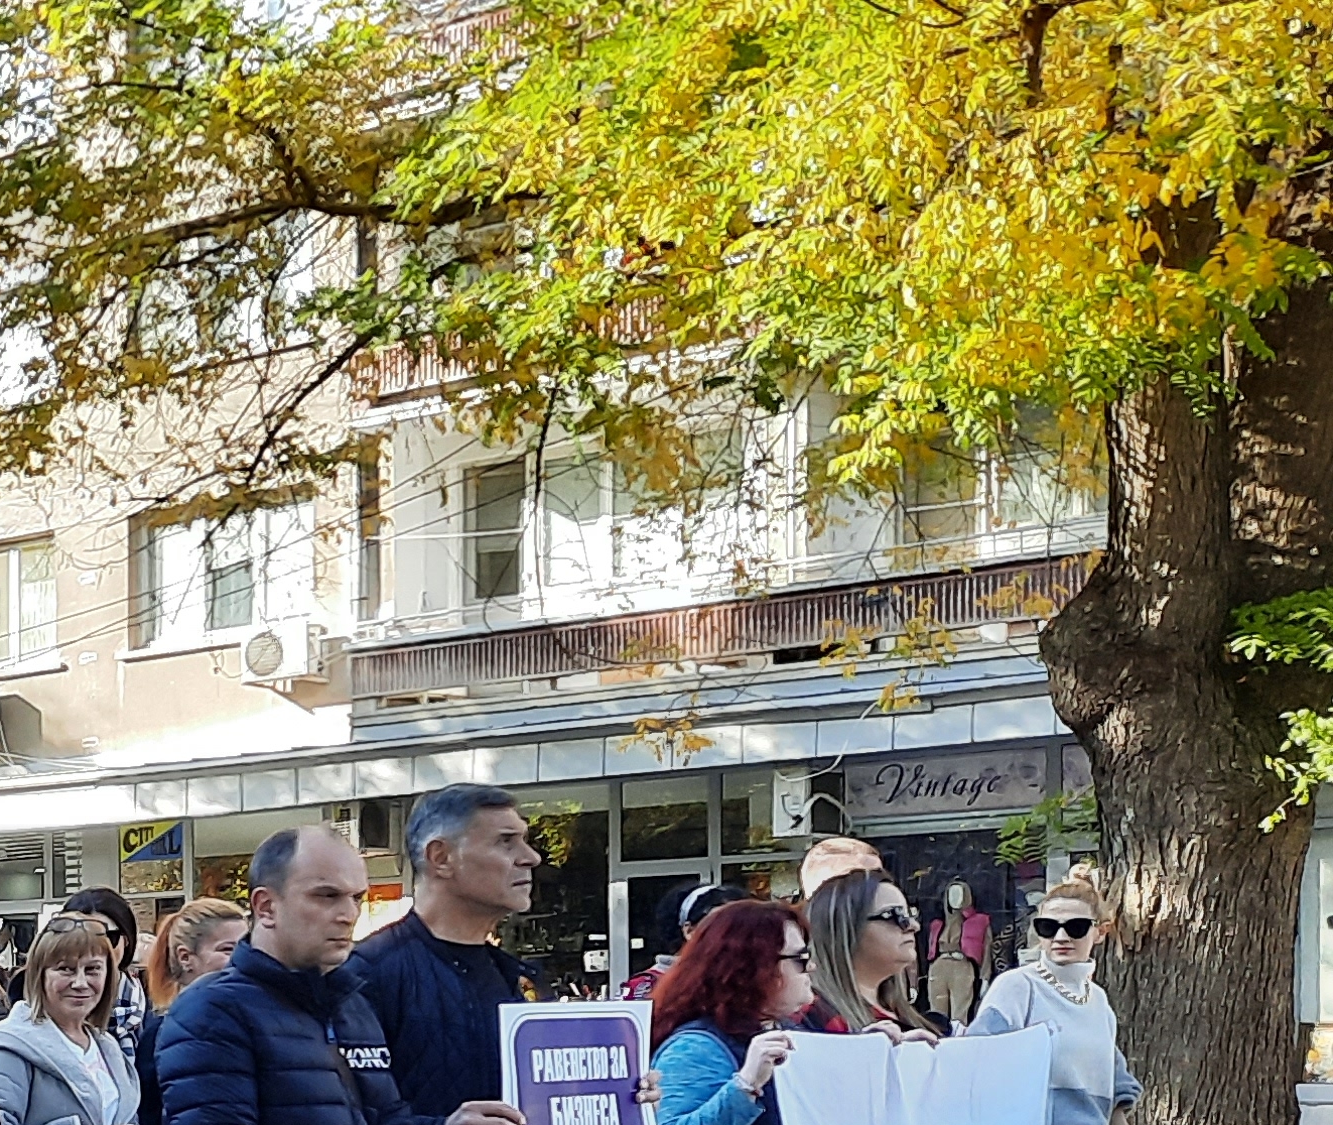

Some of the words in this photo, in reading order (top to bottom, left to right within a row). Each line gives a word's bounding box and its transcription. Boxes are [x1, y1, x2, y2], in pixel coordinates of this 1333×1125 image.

[876, 763, 1002, 806] Vintage
[531, 1047, 609, 1083] РАВЕНСТВО
[610, 1046, 629, 1079] ЗА
